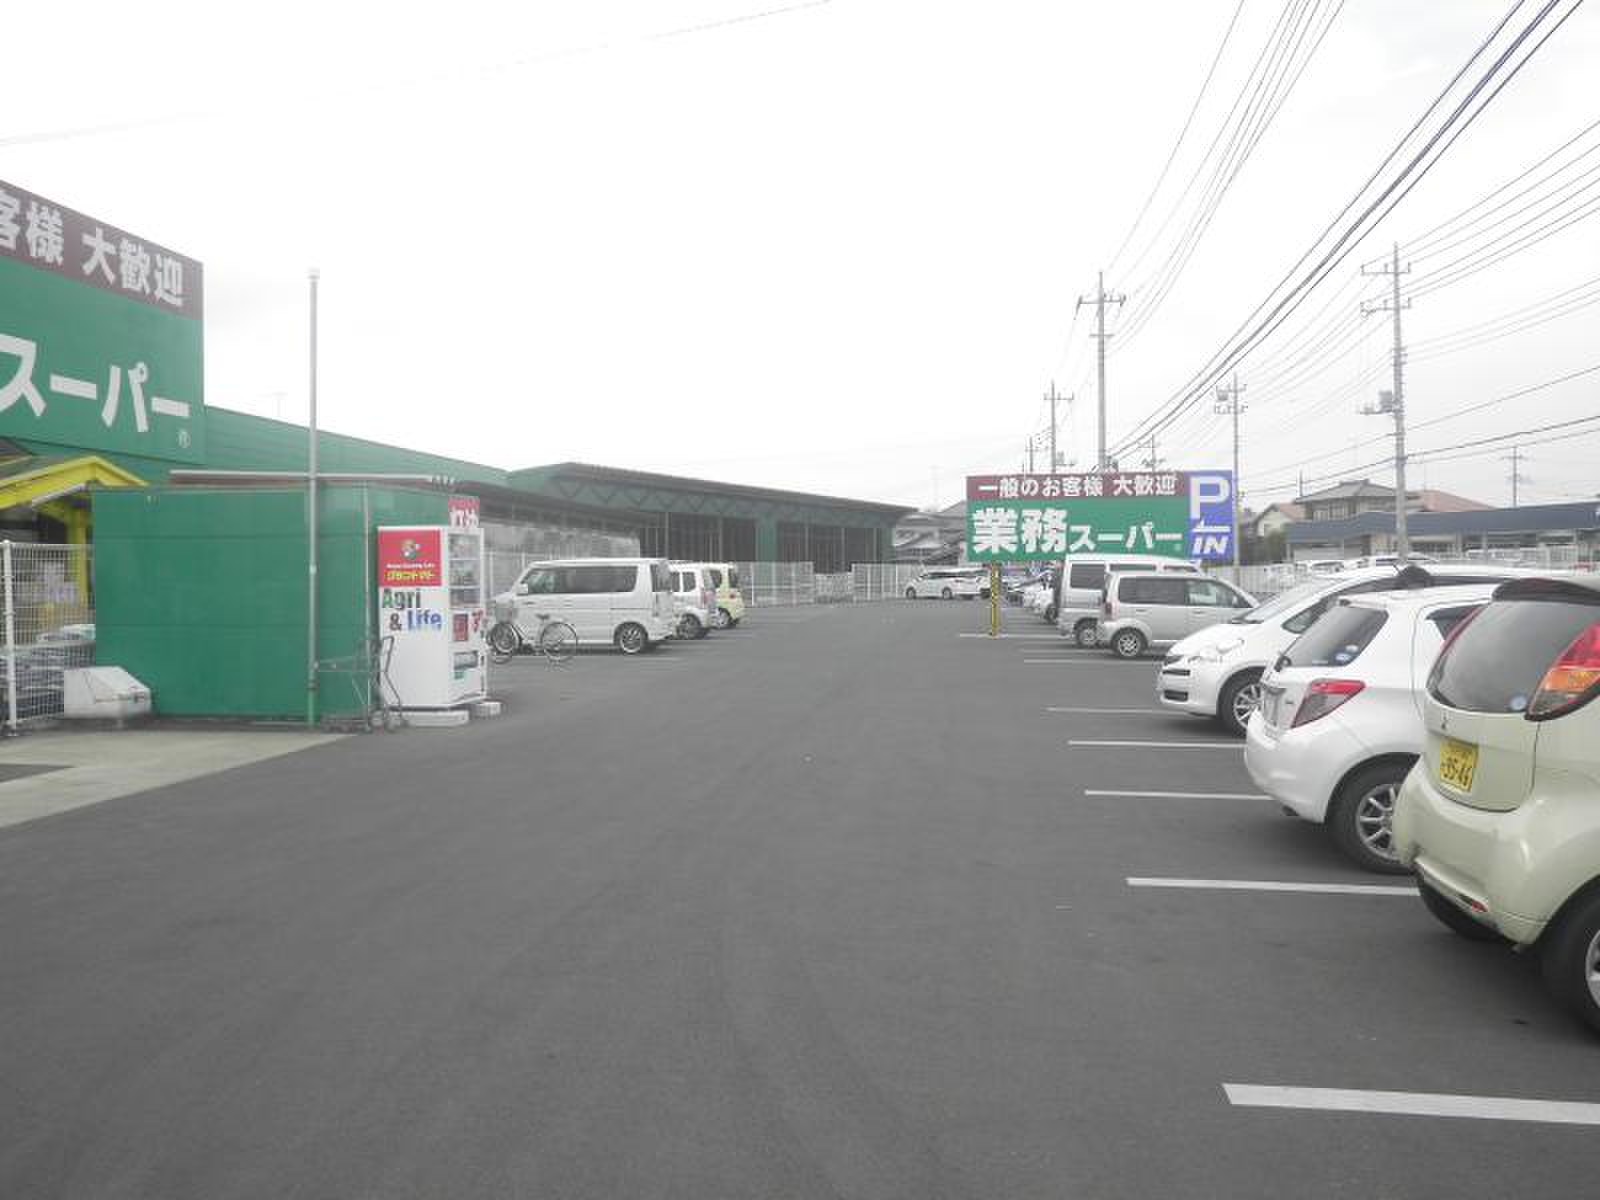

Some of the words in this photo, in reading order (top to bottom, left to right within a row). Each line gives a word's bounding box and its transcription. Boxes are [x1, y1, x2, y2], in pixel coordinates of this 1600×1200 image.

[81, 226, 183, 307] 大歓迎
[0, 333, 190, 433] スーパー
[978, 476, 1103, 498] 一般のお客様
[1112, 475, 1178, 497] 大歓迎
[1190, 476, 1230, 518] P
[972, 507, 1183, 554] 業務スーパー
[1192, 534, 1229, 554] IN
[382, 588, 421, 611] Agri
[389, 613, 402, 631] &
[407, 610, 442, 631] Life
